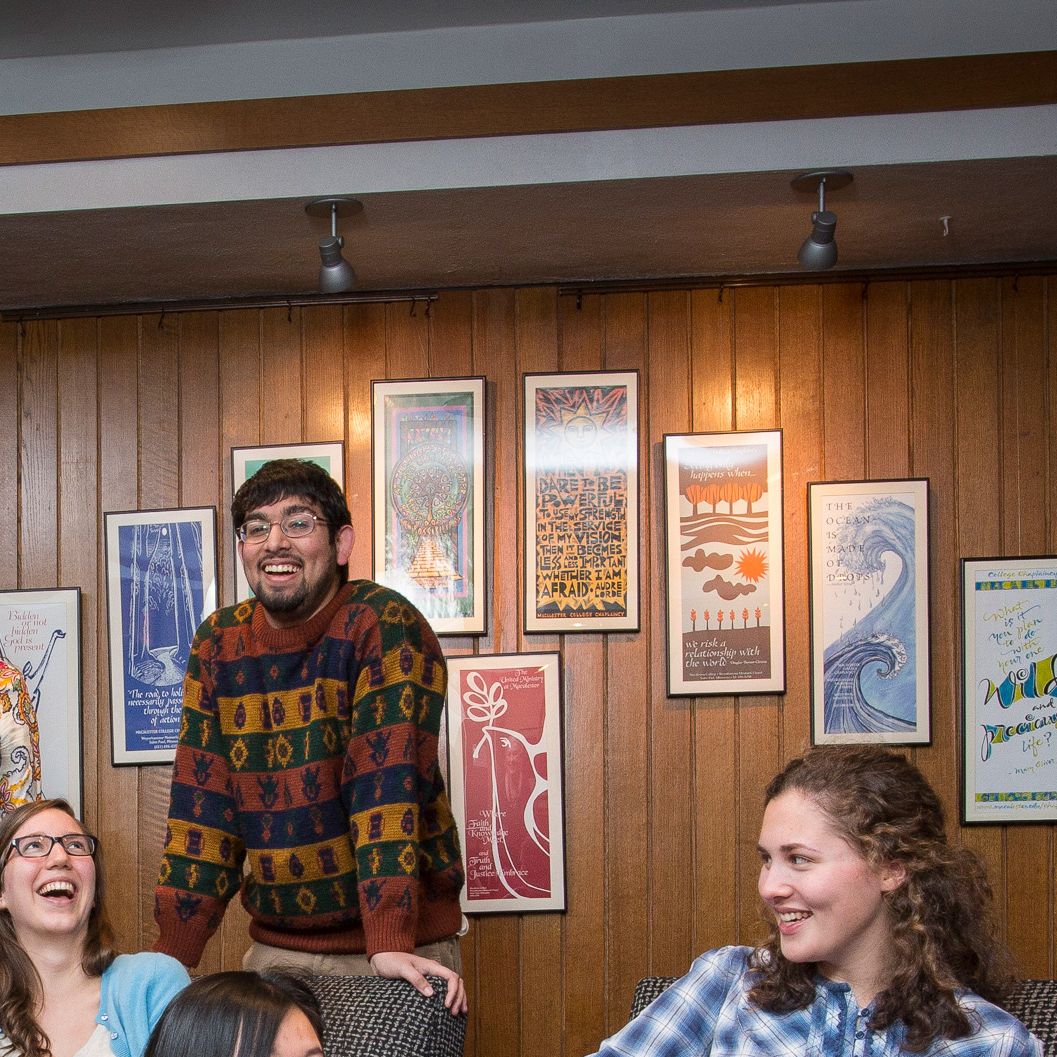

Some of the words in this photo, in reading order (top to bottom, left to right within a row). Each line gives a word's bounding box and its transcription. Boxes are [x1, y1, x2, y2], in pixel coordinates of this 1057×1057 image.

[690, 469, 724, 482] happens
[539, 478, 578, 494] DARE
[597, 476, 622, 492] BE
[542, 492, 624, 508] POWERFUL
[552, 508, 569, 520] USE
[579, 507, 625, 521] STRENGTH
[826, 516, 870, 525] OCEAN
[538, 523, 547, 532] IN
[548, 521, 568, 532] THE
[574, 521, 622, 532] SERVICE
[542, 534, 554, 544] OF
[557, 534, 572, 544] MY
[826, 531, 837, 539] IS
[540, 545, 563, 555] THEN
[566, 545, 575, 554] IT
[577, 544, 623, 556] BECOMES
[826, 544, 864, 553] MADE
[540, 556, 561, 570] LESS
[579, 555, 626, 568] IMPORTANT
[826, 559, 843, 567] OF
[541, 570, 592, 581] WHETHER
[595, 570, 602, 579] I
[605, 569, 621, 579] AM
[827, 573, 870, 581] DROPS
[988, 571, 1016, 579] College
[595, 582, 622, 590] AUDRE
[595, 590, 622, 598] LORDE
[9, 611, 39, 620] Bidden
[983, 600, 1030, 621] What
[1004, 618, 1014, 627] is
[11, 626, 38, 637] bidden
[989, 630, 1012, 645] you
[1017, 619, 1043, 639] plan
[1024, 629, 1040, 640] do
[4, 635, 23, 647] God
[685, 640, 698, 648] we
[700, 638, 718, 648] risk
[1000, 637, 1042, 656] with
[14, 643, 44, 653] present
[685, 647, 737, 659] relationship
[740, 646, 760, 656] with
[685, 657, 700, 667] the
[703, 657, 728, 667] world
[998, 656, 1022, 675] your
[1025, 646, 1045, 660] one
[128, 696, 165, 707] necessarily
[1032, 698, 1056, 711] and
[144, 705, 169, 717] through
[151, 715, 157, 726] of
[468, 820, 489, 829] Faith
[469, 857, 490, 866] Truth
[470, 870, 495, 880] Justice
